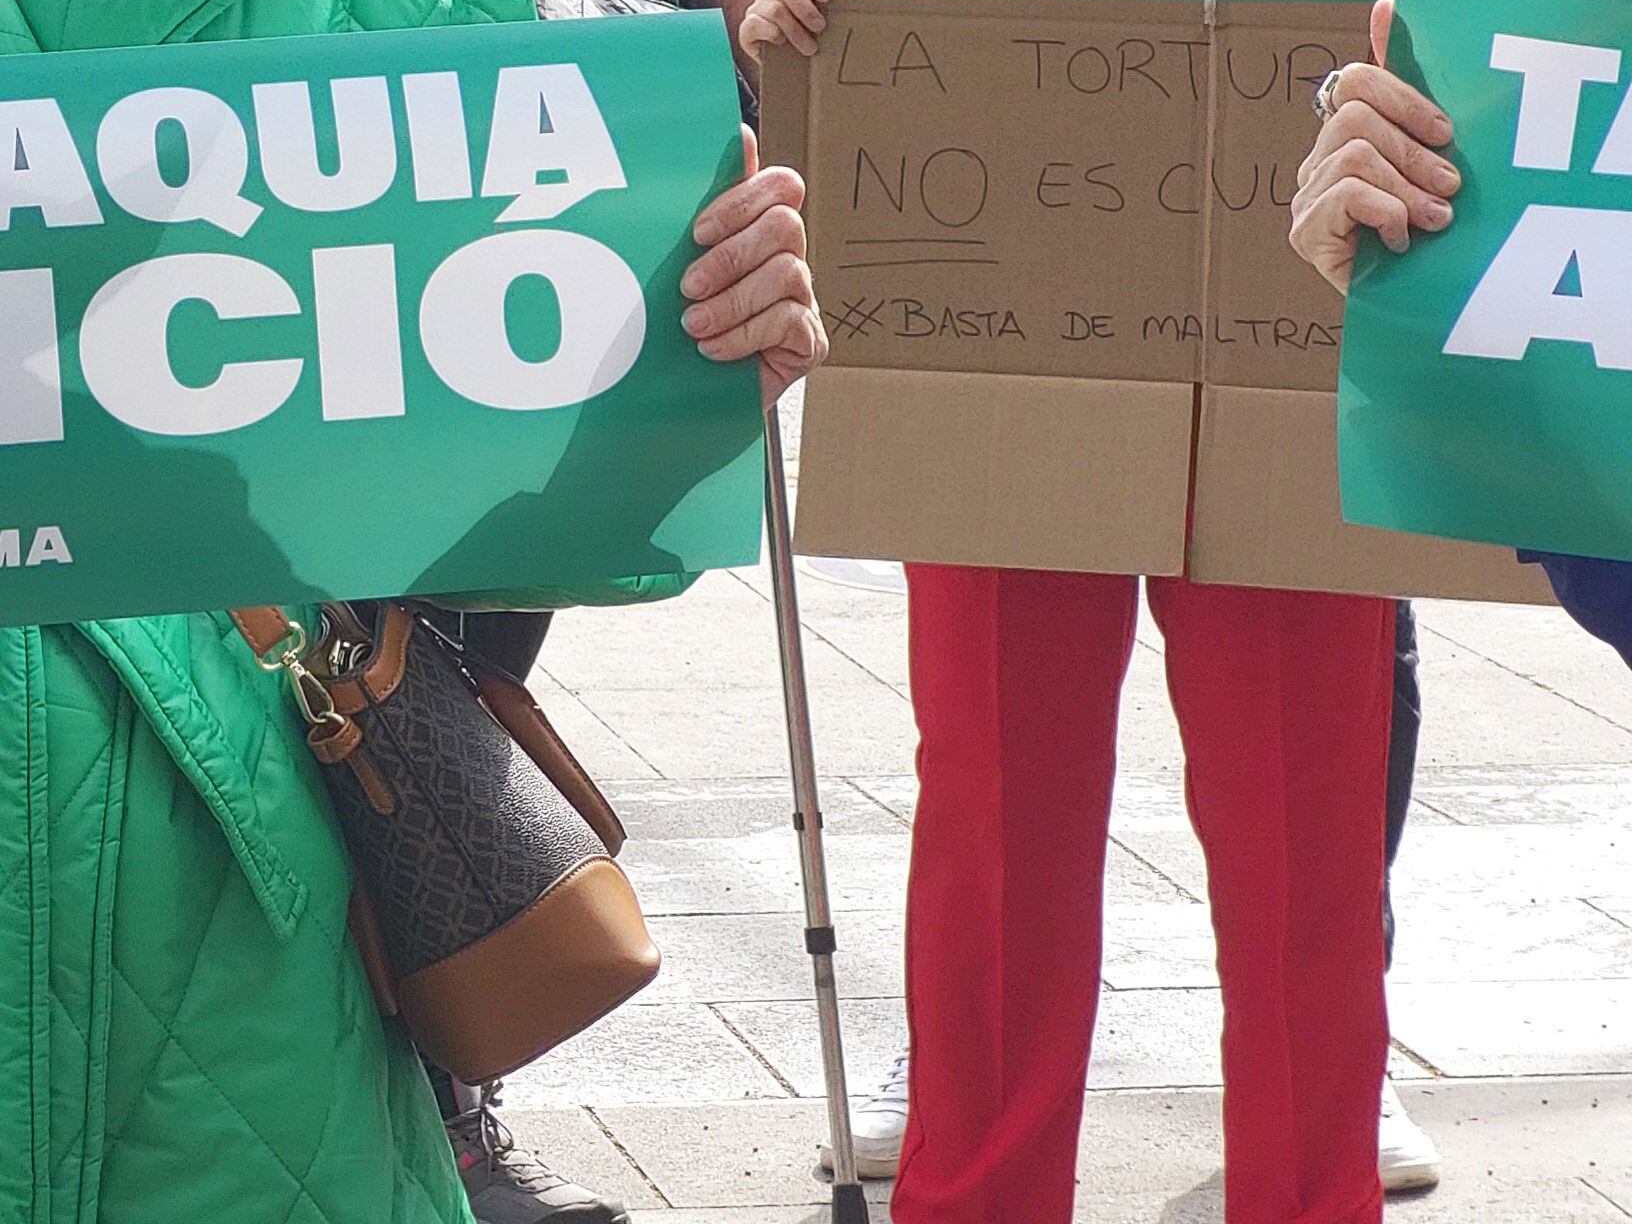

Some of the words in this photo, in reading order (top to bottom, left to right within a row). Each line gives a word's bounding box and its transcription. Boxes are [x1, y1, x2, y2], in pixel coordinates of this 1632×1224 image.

[835, 27, 947, 94] LA
[1011, 38, 1337, 104] TORTUR
[1489, 32, 1632, 176] T
[852, 146, 988, 228] NO
[1036, 162, 1125, 212] ES
[1063, 311, 1116, 341] DE
